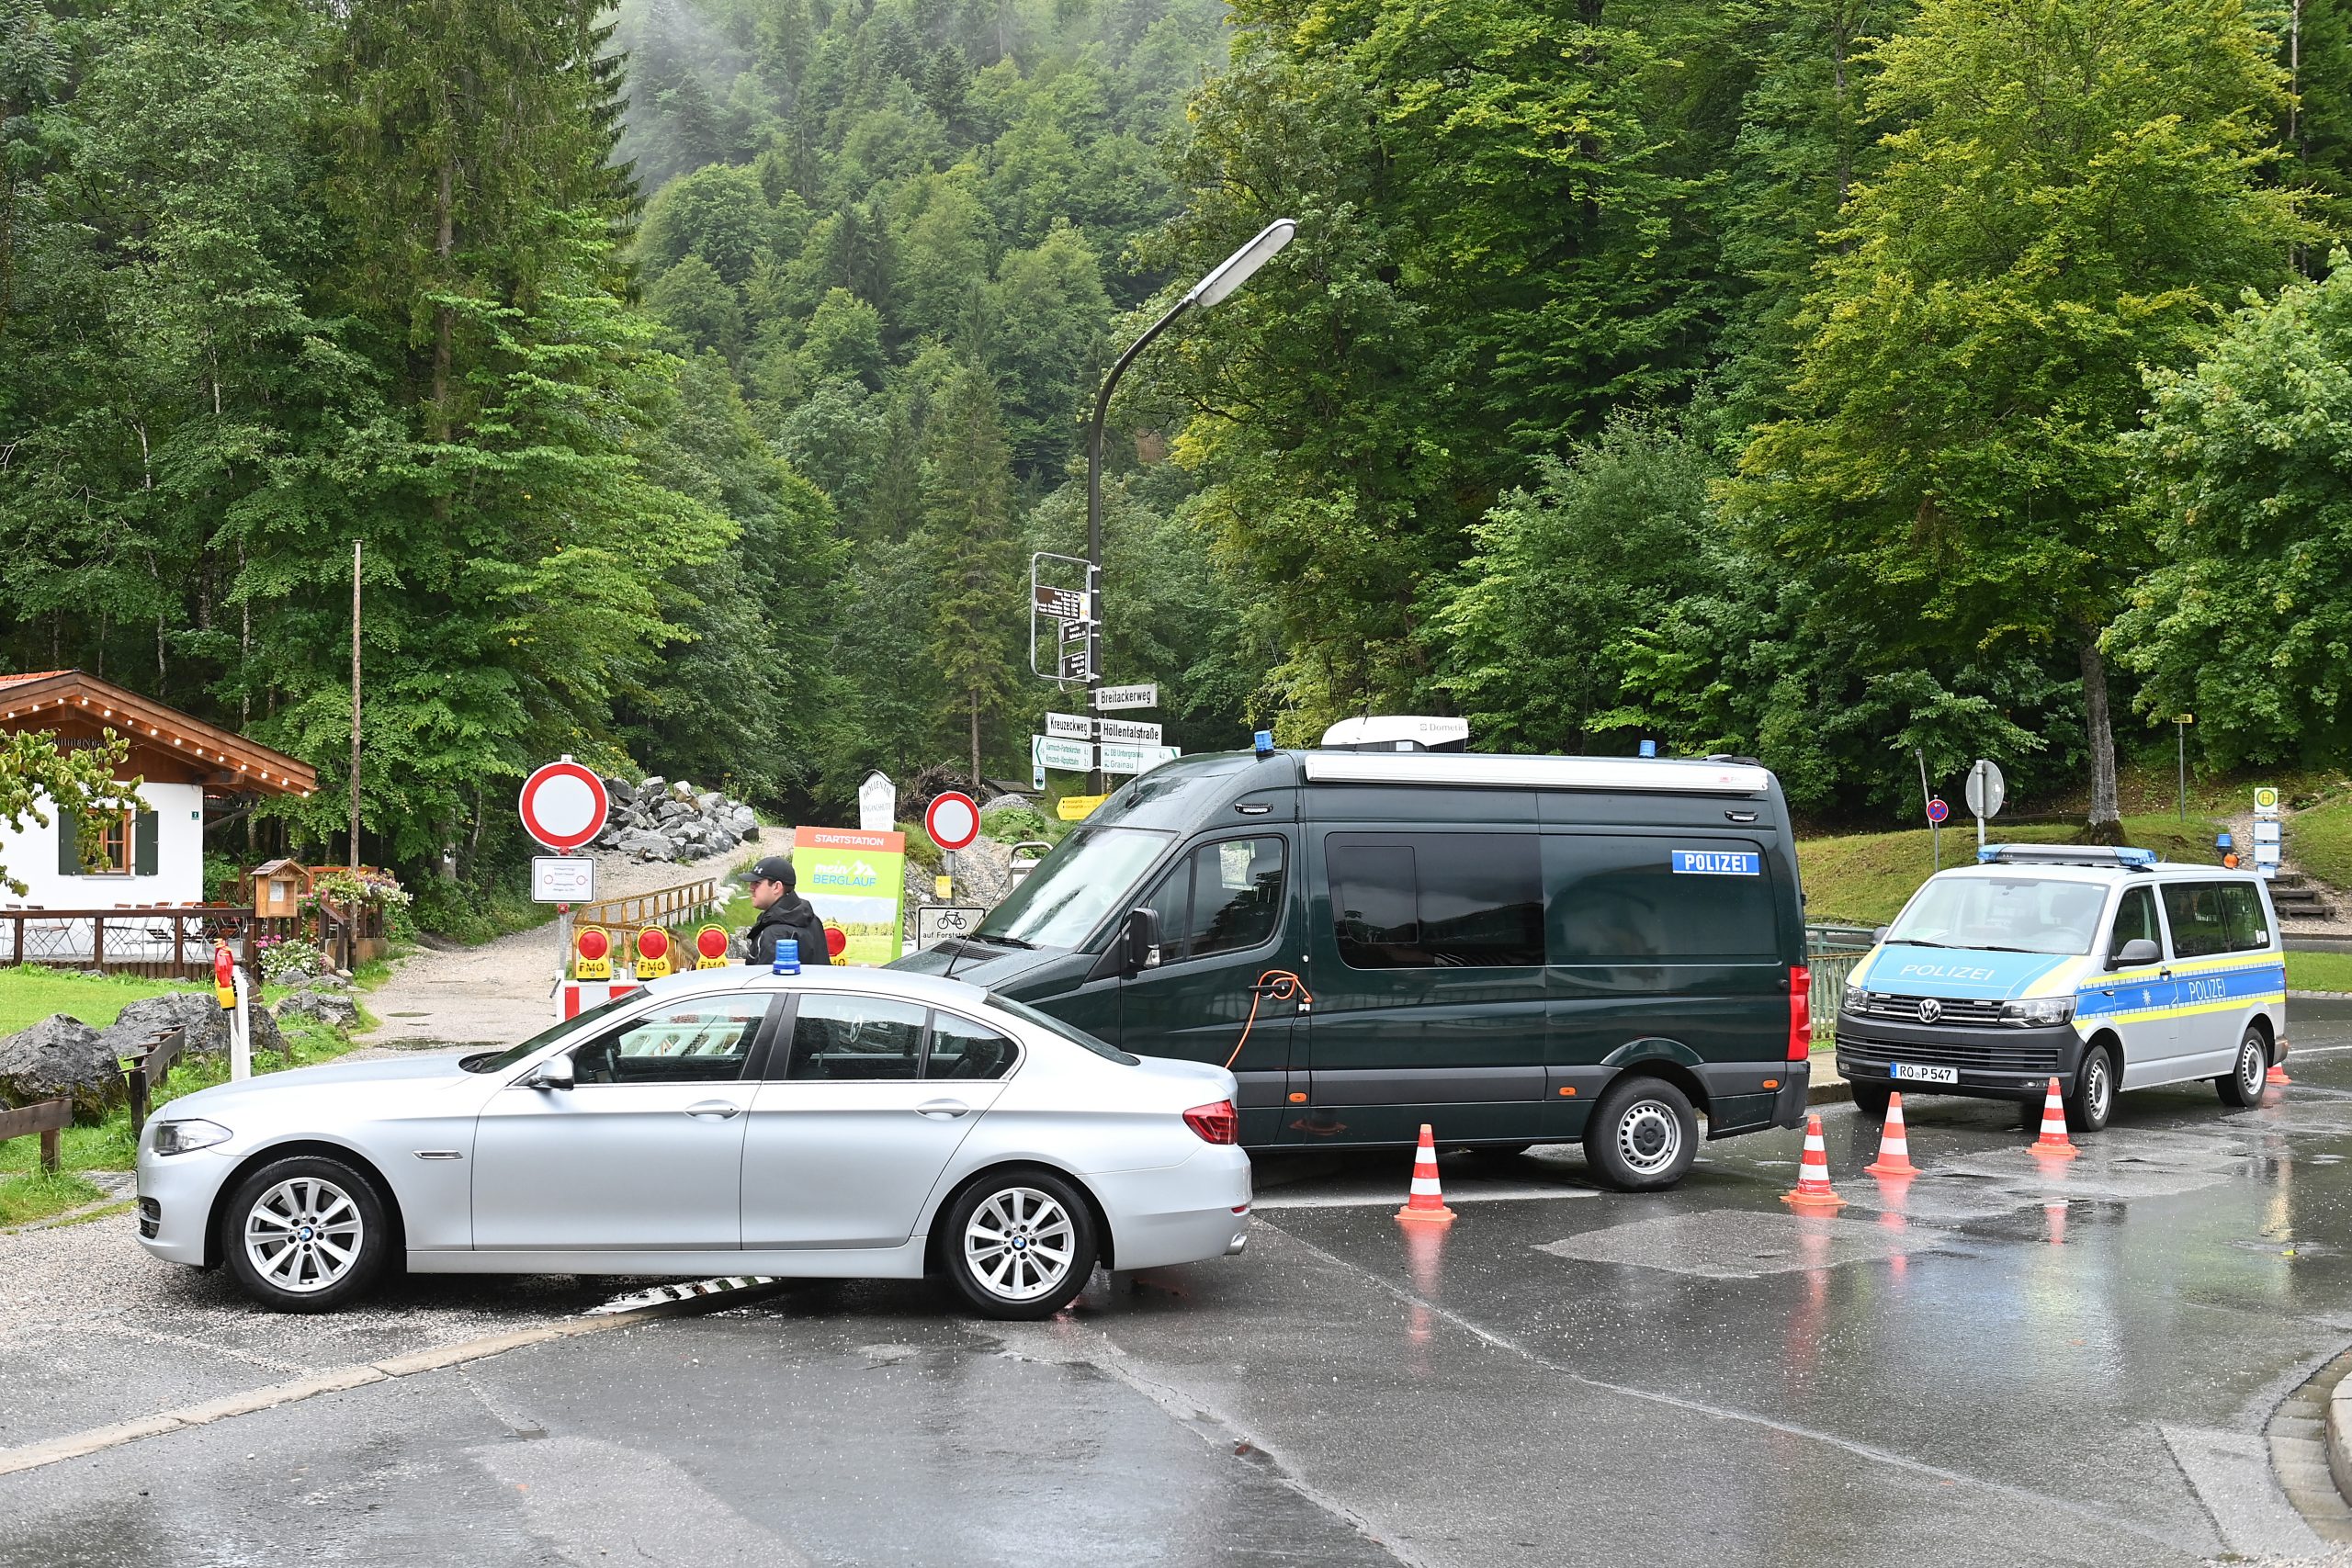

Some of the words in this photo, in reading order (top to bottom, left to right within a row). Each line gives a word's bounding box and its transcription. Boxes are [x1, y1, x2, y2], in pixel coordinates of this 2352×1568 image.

[1101, 689, 1151, 704] Breitackerweg
[1050, 716, 1088, 736] Kreuzeckweg
[1103, 722, 1159, 739] Höllentalstraße
[1430, 723, 1464, 731] Dometic
[1116, 749, 1144, 760] Untergrainau
[1110, 761, 1134, 769] Grainau
[815, 834, 884, 845] STARTSTATION
[815, 861, 846, 874] mein
[1684, 853, 1747, 872] POLIZEI
[813, 874, 876, 886] BERGLAUF
[1900, 964, 1996, 980] POLIZEI
[2188, 977, 2226, 1001] POLIZEI
[1900, 1066, 1914, 1077] RO
[1921, 1067, 1928, 1078] P
[1930, 1068, 1951, 1081] 547
